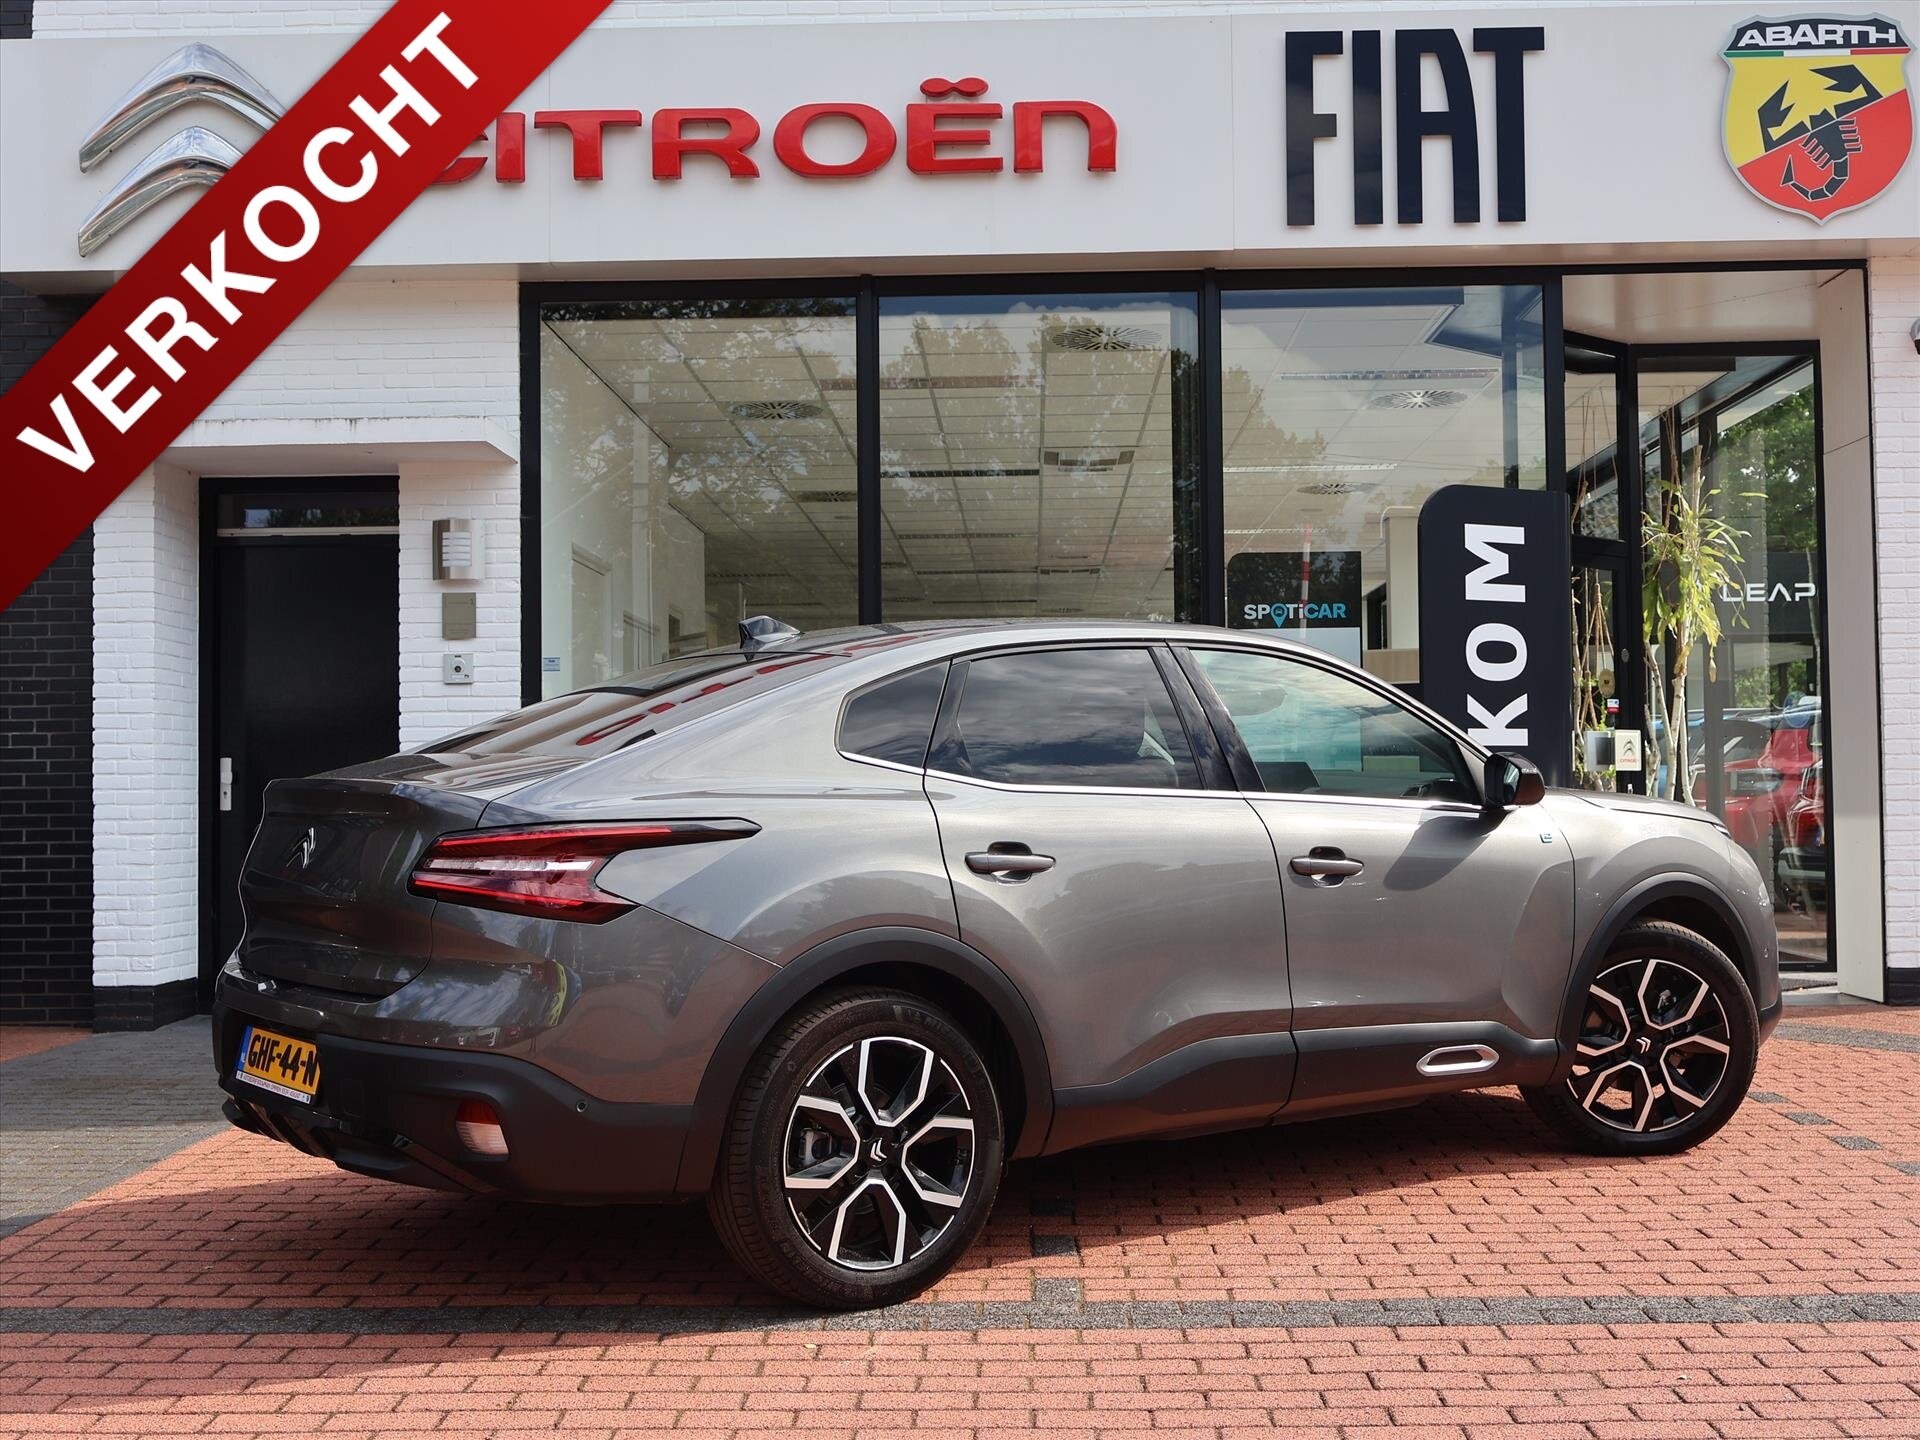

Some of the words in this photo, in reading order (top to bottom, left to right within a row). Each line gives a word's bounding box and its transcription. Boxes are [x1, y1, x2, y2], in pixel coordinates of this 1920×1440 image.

[1736, 23, 1897, 47] ABARTH
[1284, 26, 1546, 227] FIAT
[1721, 582, 1817, 602] LEAP
[1464, 523, 1529, 747] KOM
[247, 1034, 318, 1087] GHF-44-N
